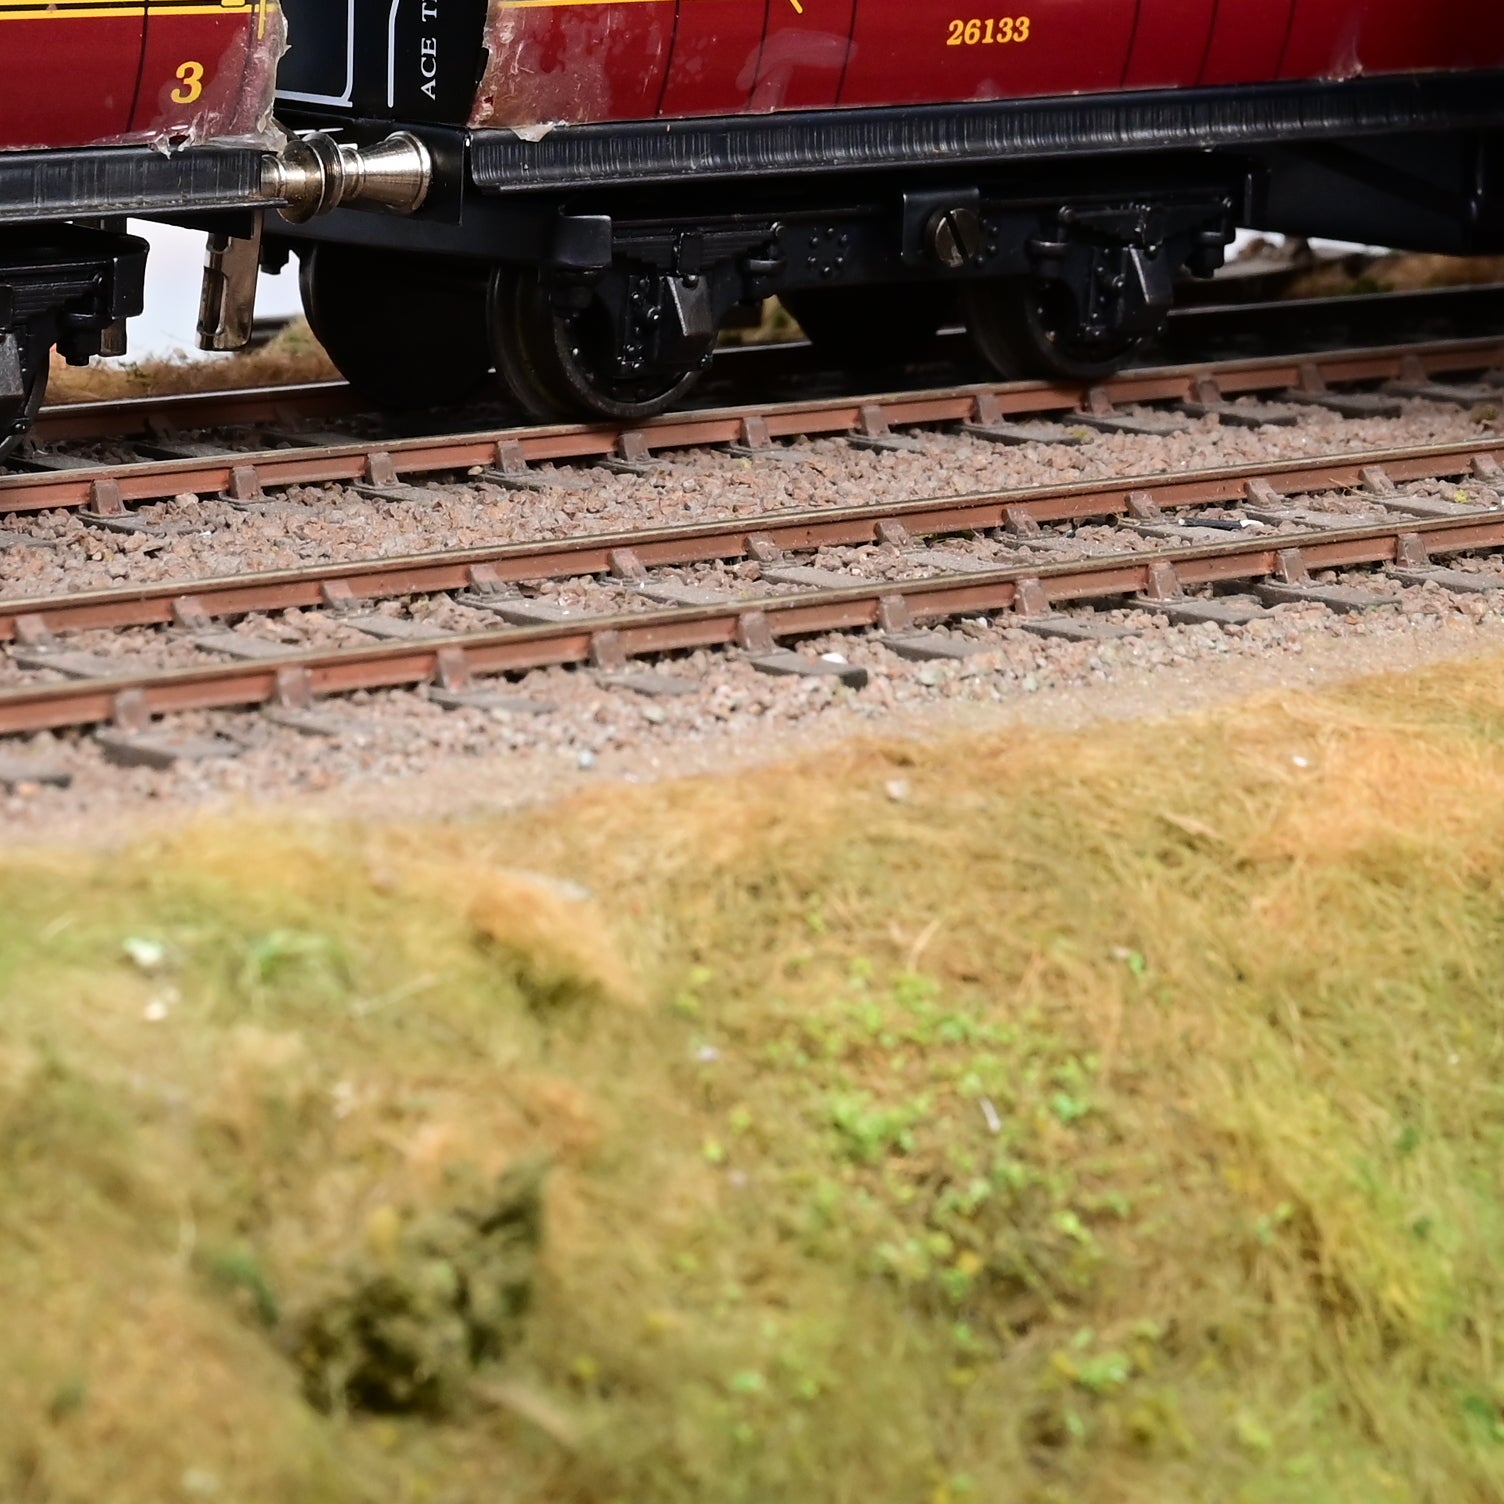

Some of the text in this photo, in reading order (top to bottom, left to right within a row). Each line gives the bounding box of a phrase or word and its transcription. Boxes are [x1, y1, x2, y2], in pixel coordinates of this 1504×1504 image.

[946, 16, 1031, 46] 26133
[170, 60, 204, 104] 3
[419, 37, 437, 101] ACE
